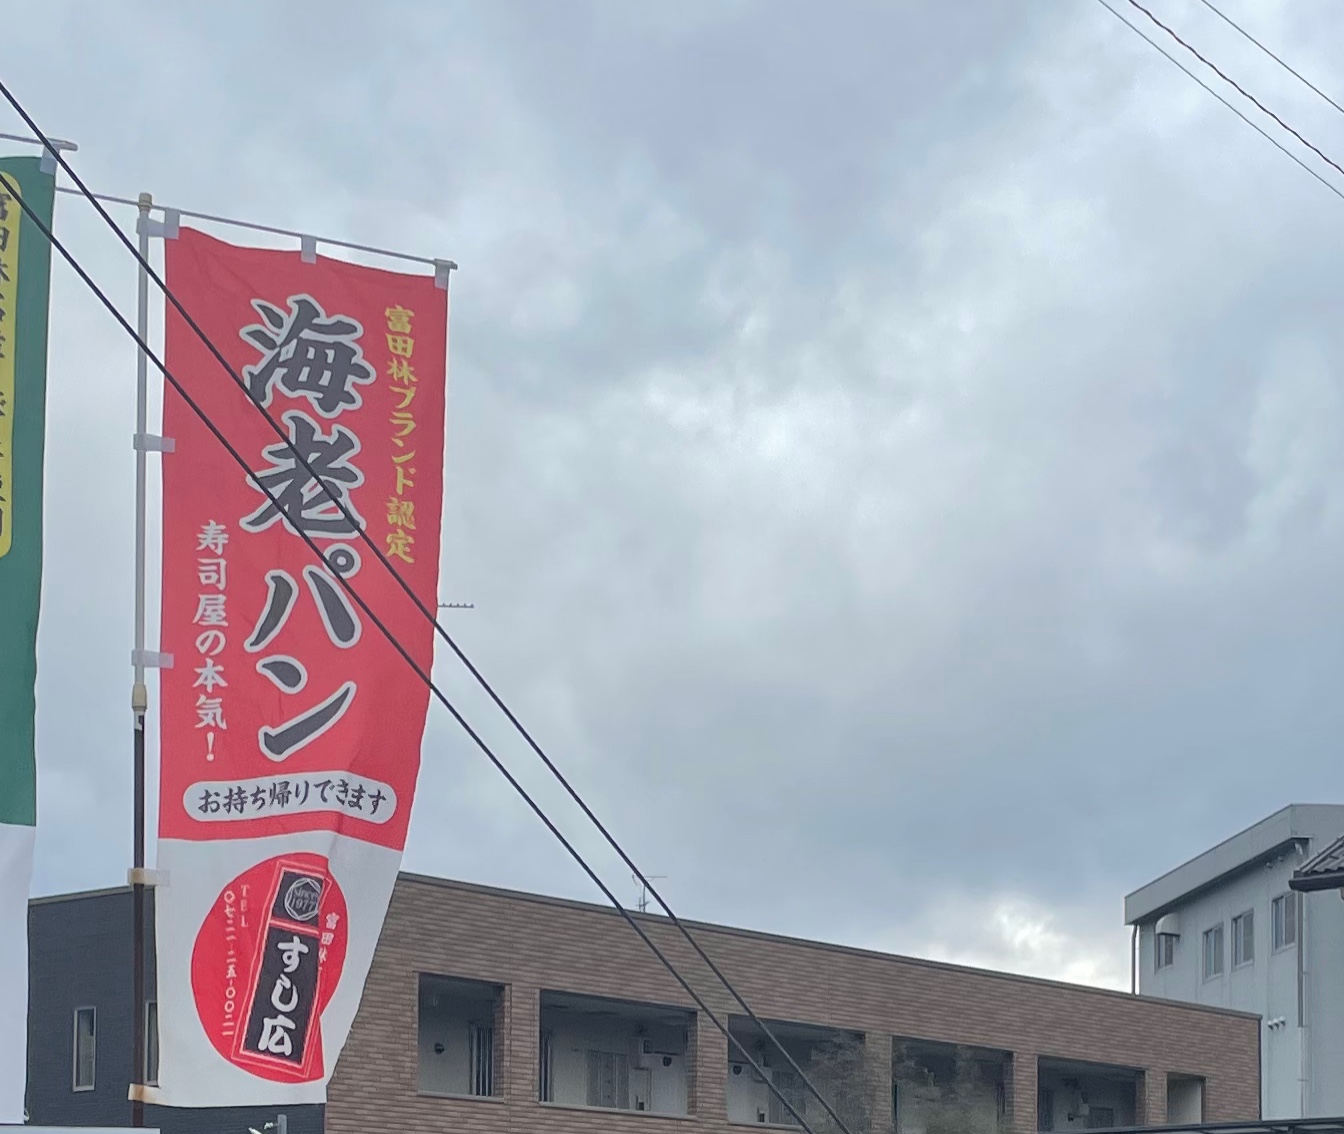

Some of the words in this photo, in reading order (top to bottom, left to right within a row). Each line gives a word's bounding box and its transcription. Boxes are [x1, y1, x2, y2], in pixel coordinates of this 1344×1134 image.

[383, 304, 419, 564] 富田林ブランド認定
[238, 293, 377, 763] 海老パン
[197, 778, 388, 817] お持ち帰りできます
[240, 884, 250, 928] TEL
[258, 936, 308, 1056] すし広
